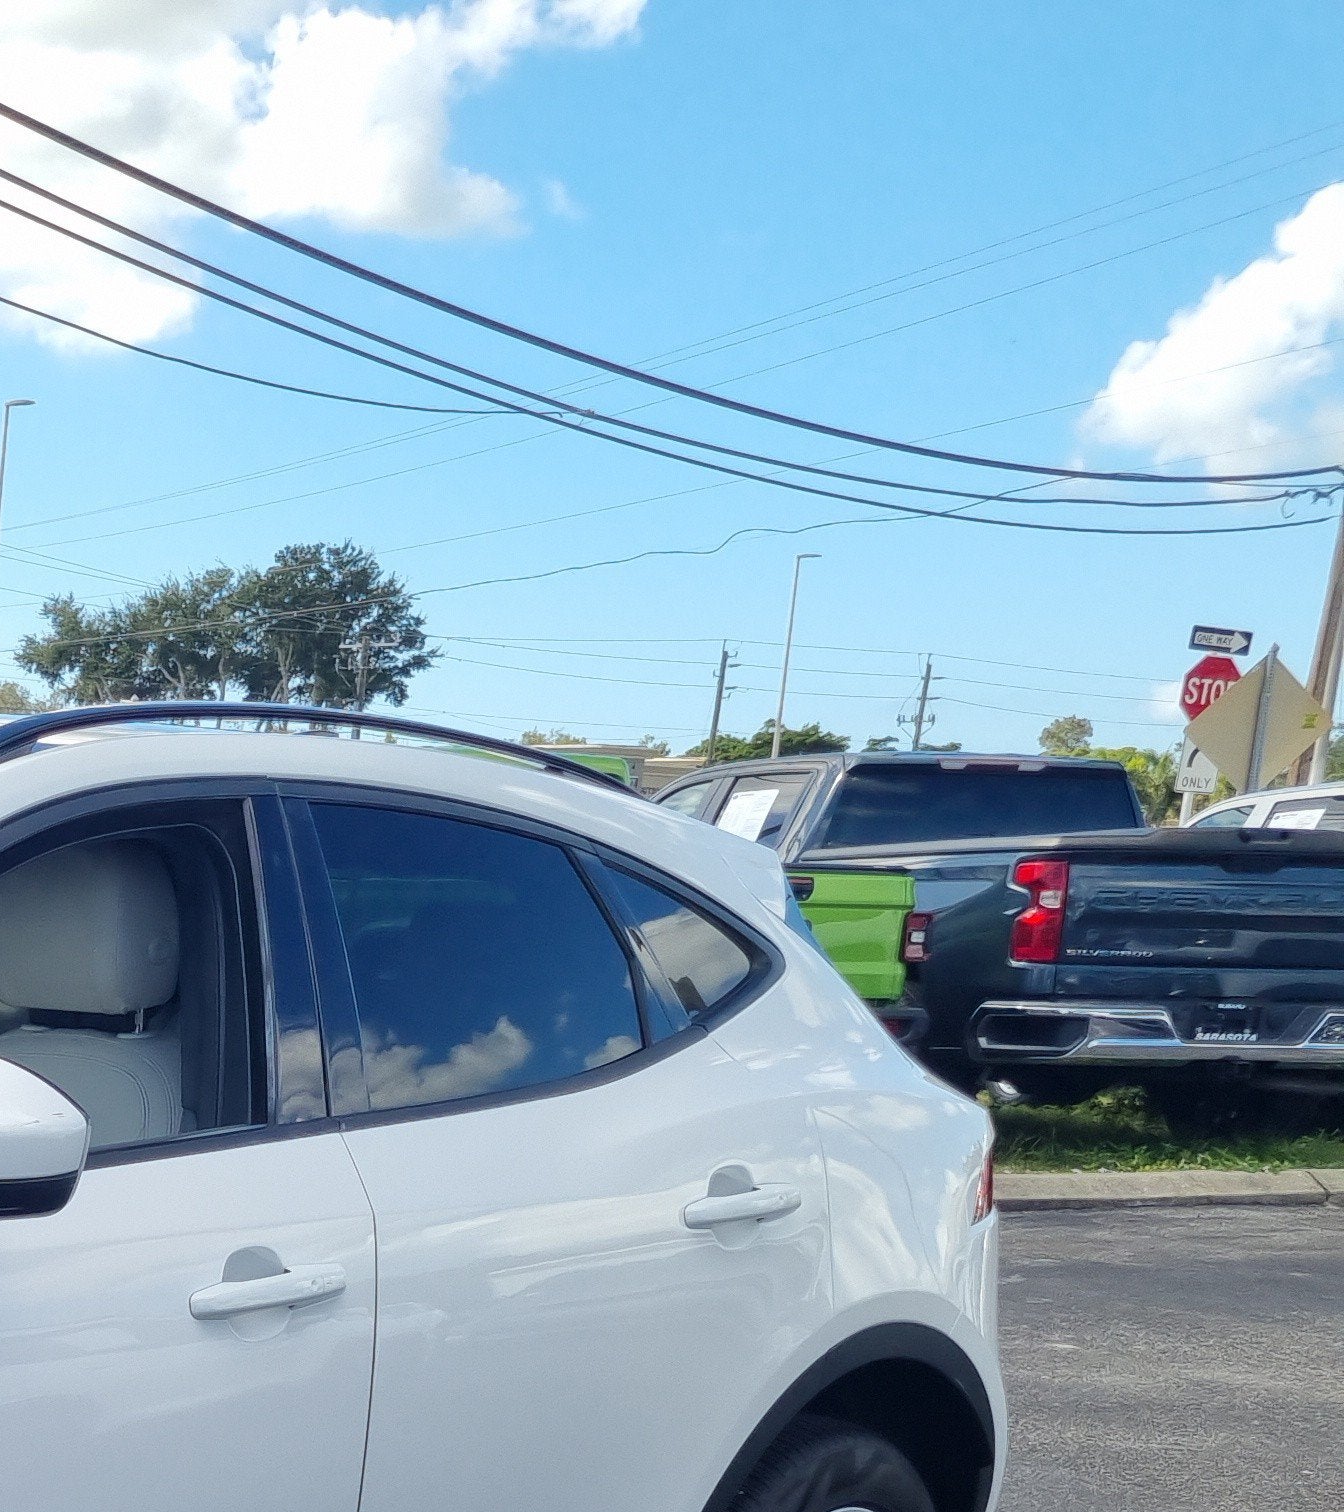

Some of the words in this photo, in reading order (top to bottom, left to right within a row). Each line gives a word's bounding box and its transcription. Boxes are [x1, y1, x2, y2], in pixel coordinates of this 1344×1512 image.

[1196, 633, 1214, 644] ONE
[1216, 635, 1233, 646] WAY
[1181, 776, 1211, 789] ONLY
[1194, 1032, 1258, 1042] SARASOTA
